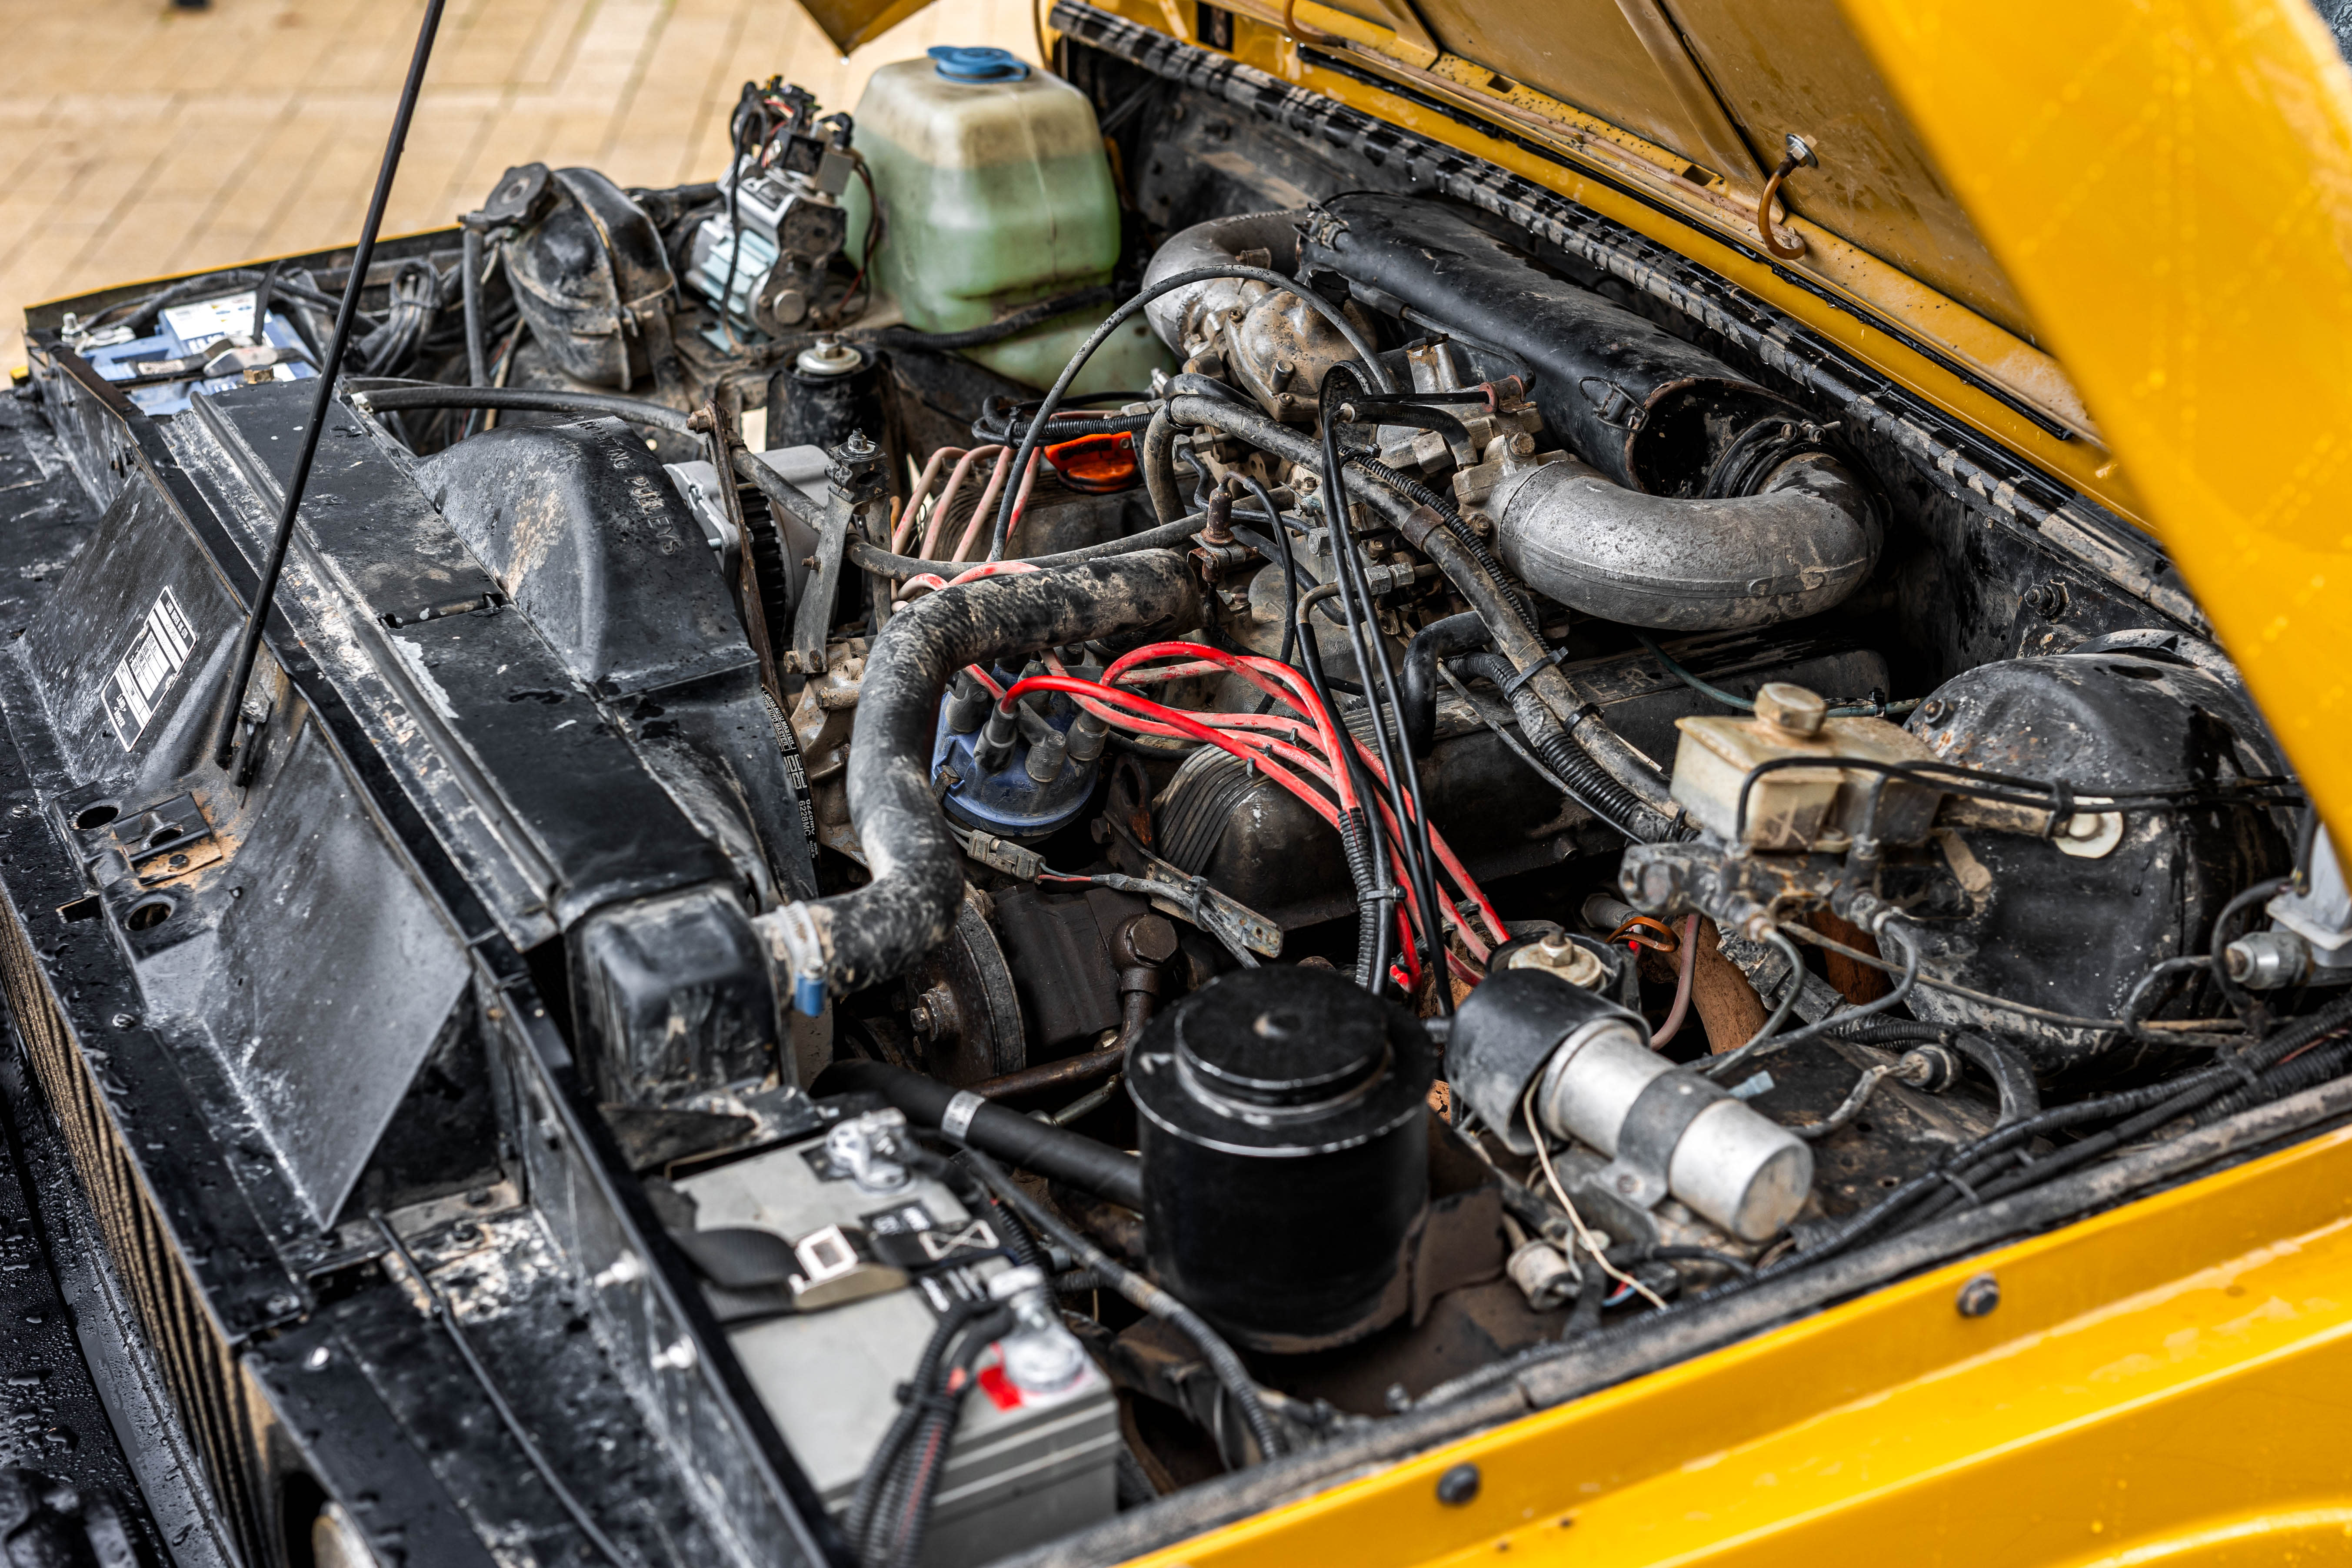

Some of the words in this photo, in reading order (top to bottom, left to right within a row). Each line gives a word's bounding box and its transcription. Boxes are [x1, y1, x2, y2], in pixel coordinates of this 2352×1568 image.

[626, 476, 683, 555] PULLEYS
[166, 600, 174, 613] LAND
[171, 610, 180, 626] ROVER
[177, 622, 184, 632] UK
[116, 693, 126, 709] LAND
[113, 709, 126, 729] ROVER
[767, 709, 777, 722] AUTO
[774, 723, 788, 746] MASTER
[1262, 742, 1305, 765] SUPPRESSN
[1359, 745, 1375, 761] NOISE
[1305, 759, 1323, 775] NOISE
[799, 800, 811, 836] 6228MC
